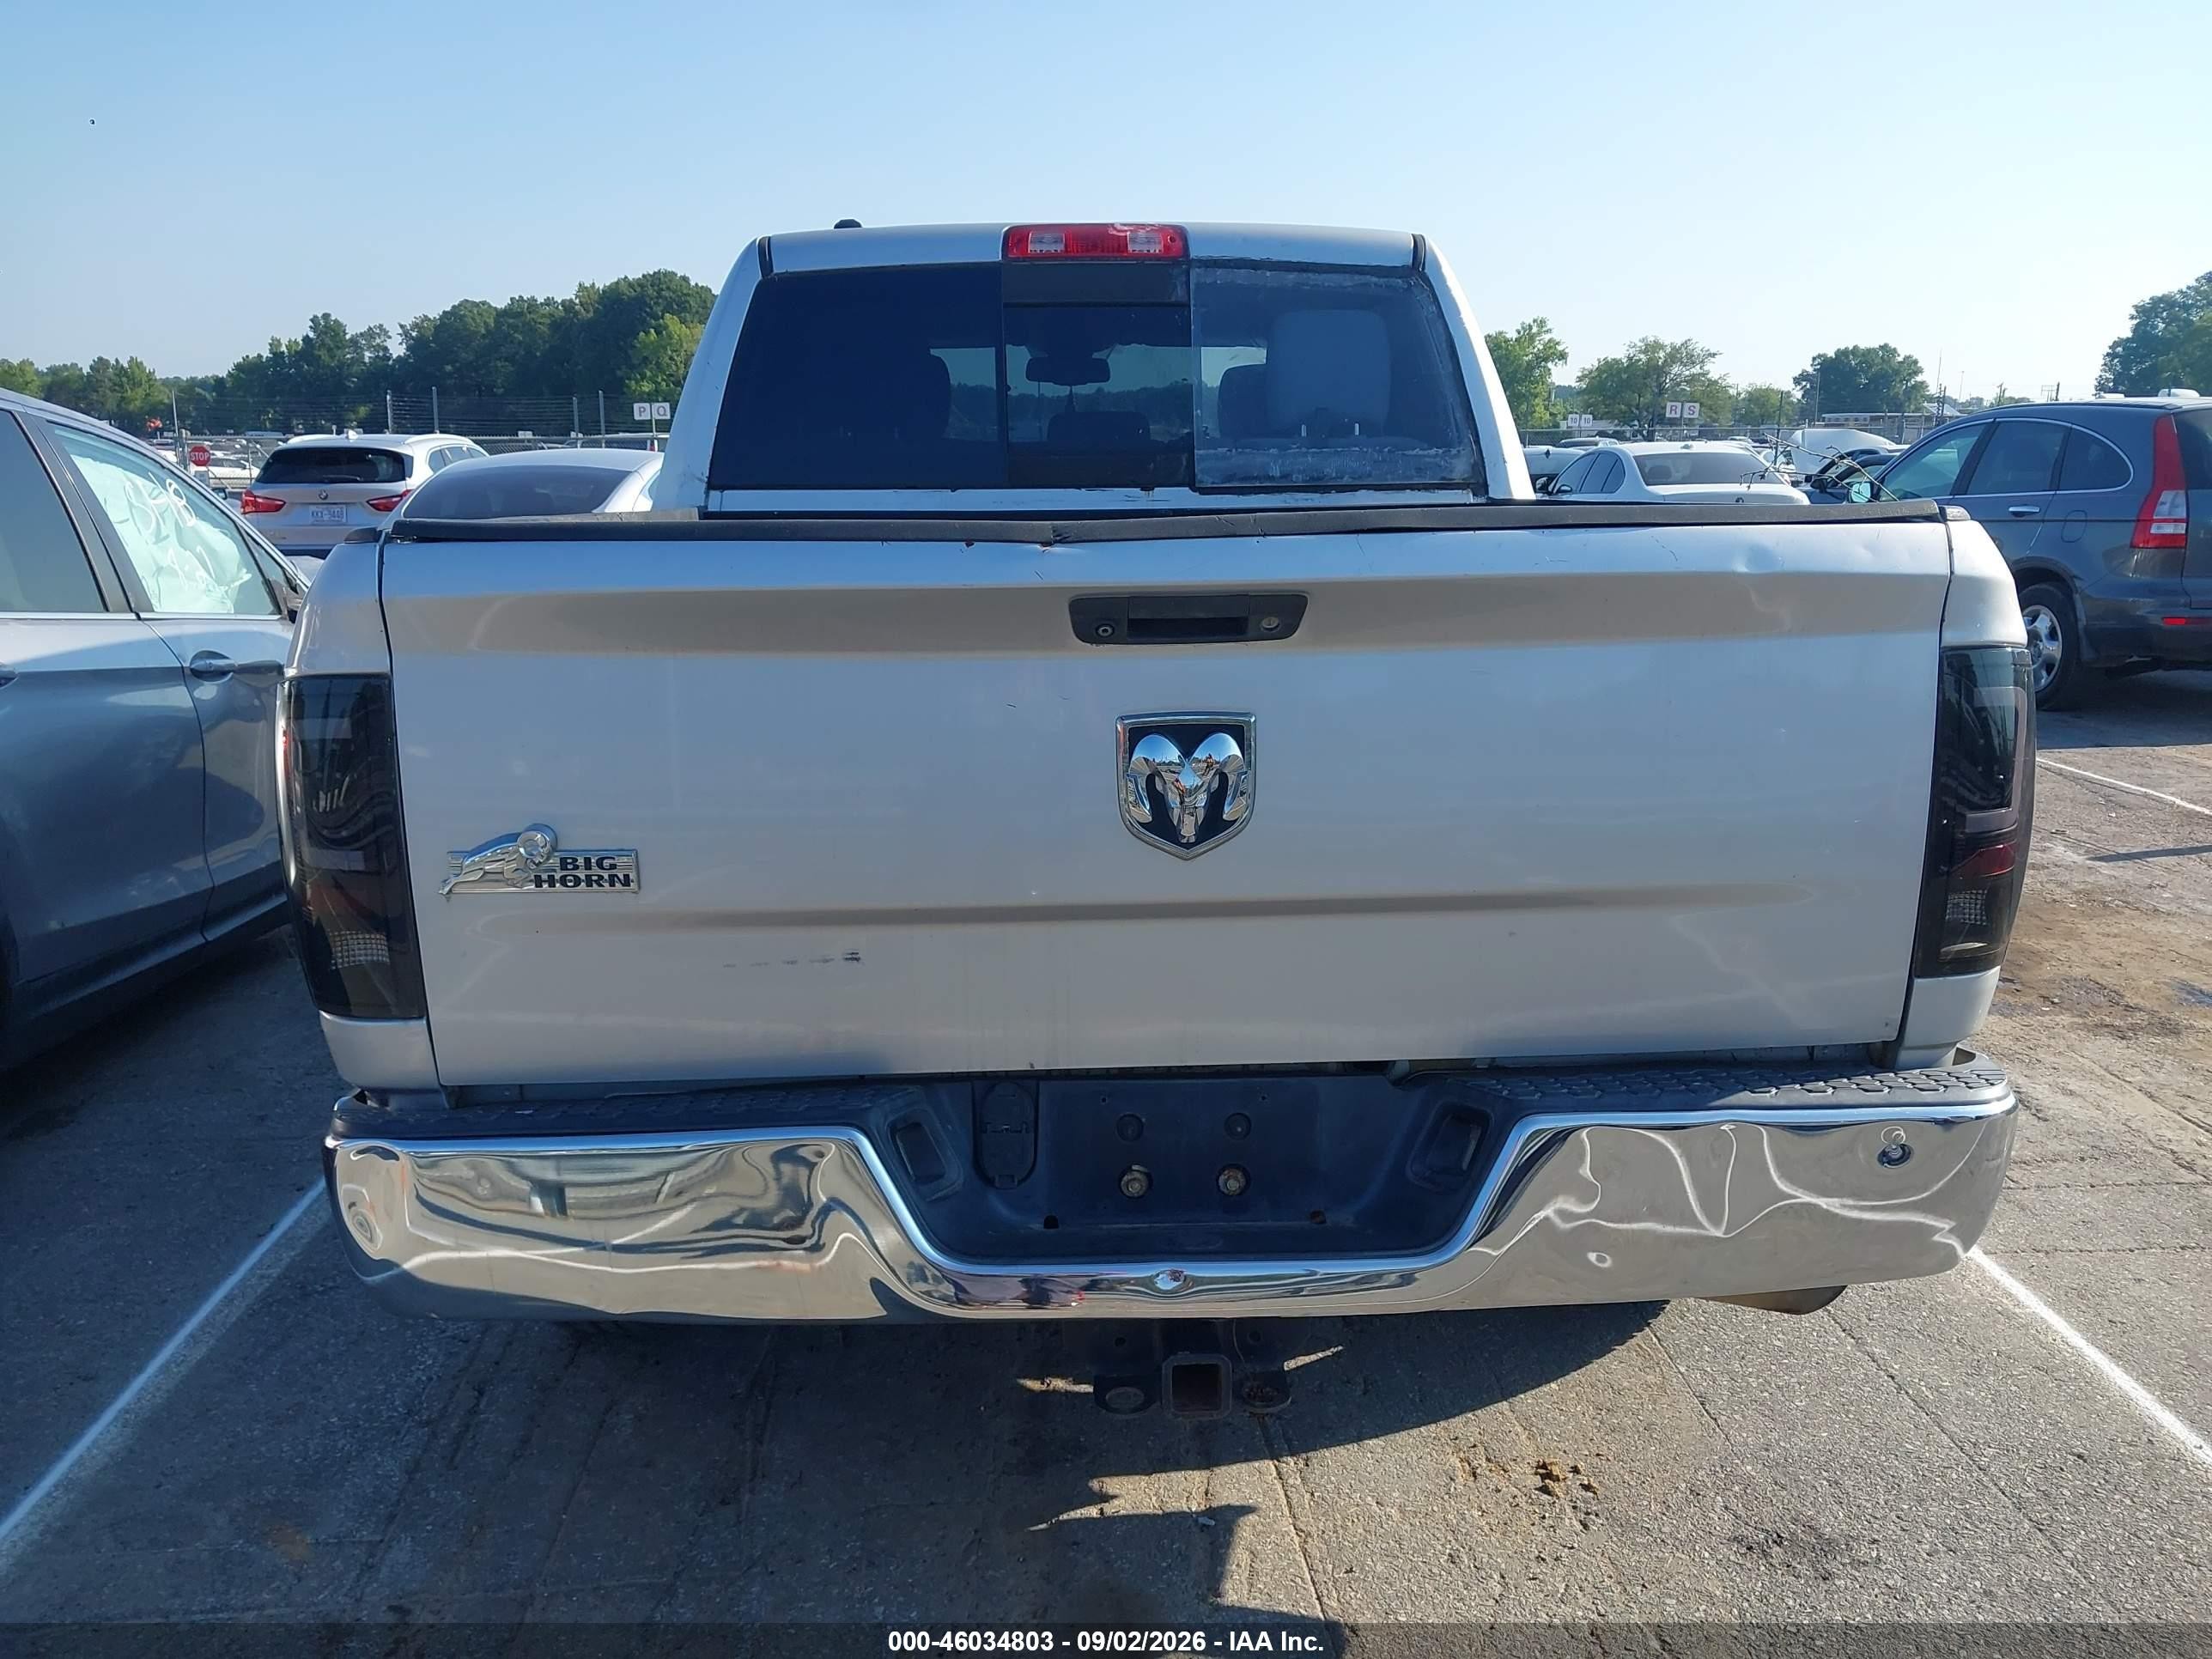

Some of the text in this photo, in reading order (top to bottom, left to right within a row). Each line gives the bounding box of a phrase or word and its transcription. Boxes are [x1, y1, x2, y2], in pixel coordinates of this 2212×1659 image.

[638, 406, 647, 417] P
[657, 405, 668, 416] Q
[1669, 405, 1678, 416] R
[1687, 405, 1696, 416] S
[191, 452, 210, 461] STOP
[560, 857, 617, 872] BIG
[534, 873, 631, 888] HORN
